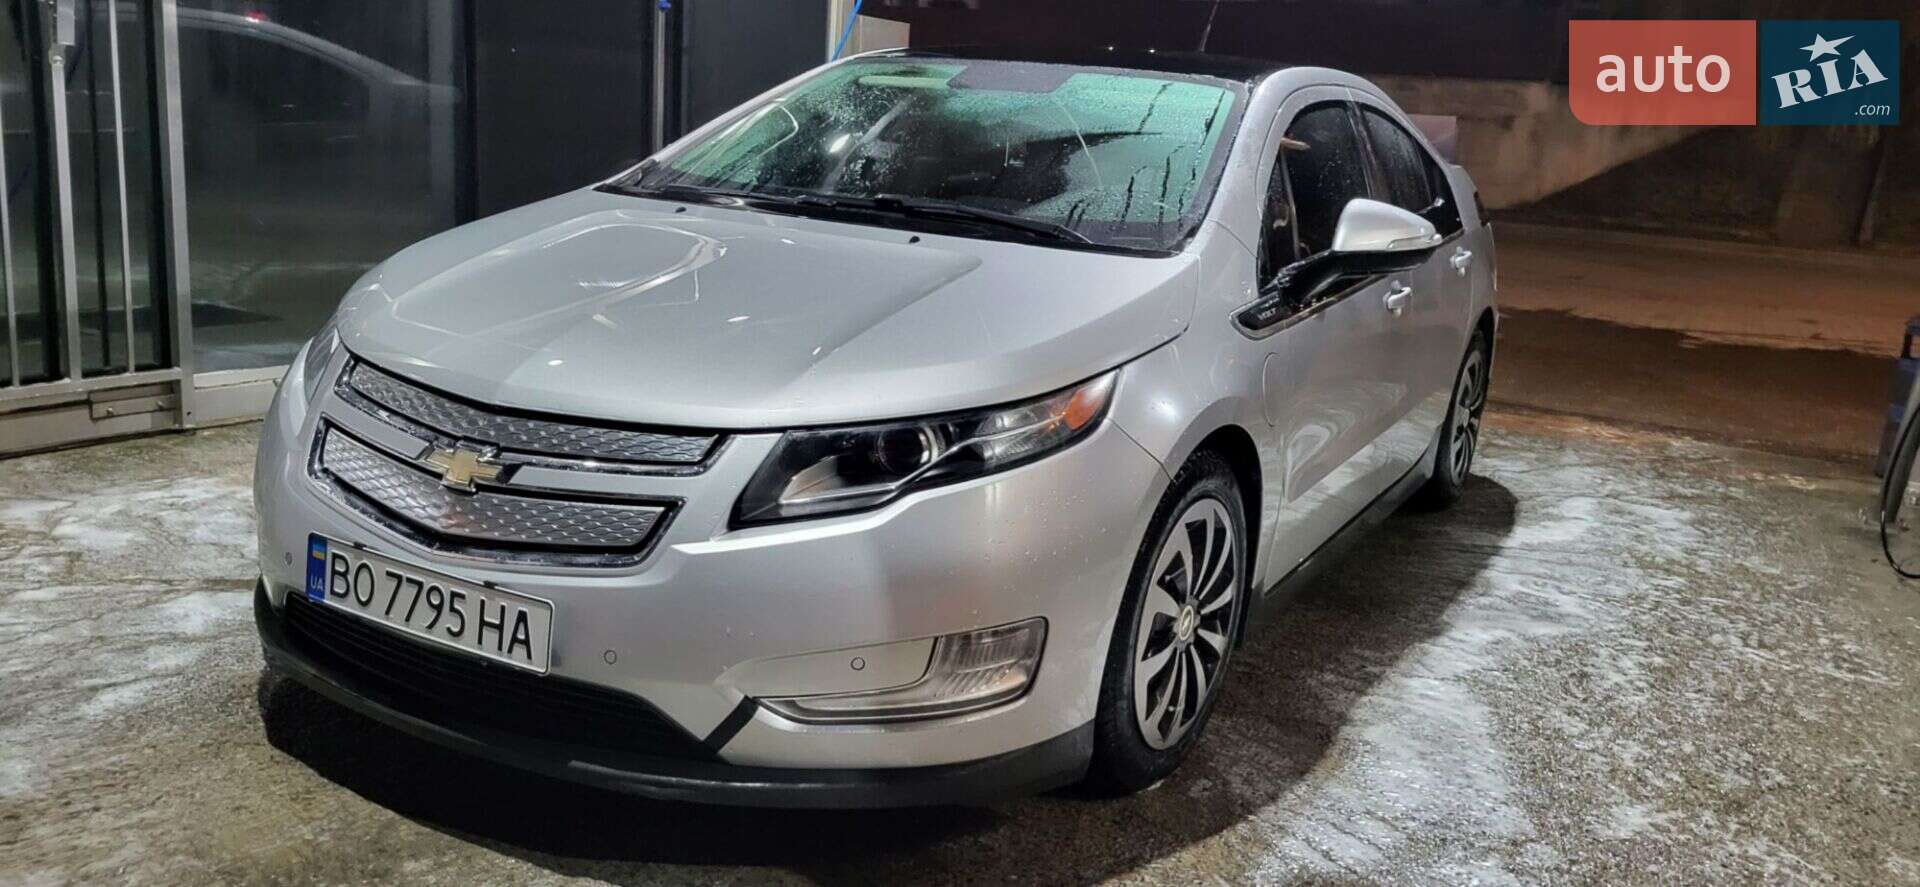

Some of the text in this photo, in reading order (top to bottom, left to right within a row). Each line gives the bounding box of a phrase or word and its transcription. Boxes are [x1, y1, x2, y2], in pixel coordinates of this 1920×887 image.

[310, 575, 324, 591] UA
[330, 551, 532, 660] BO 7795 HA
